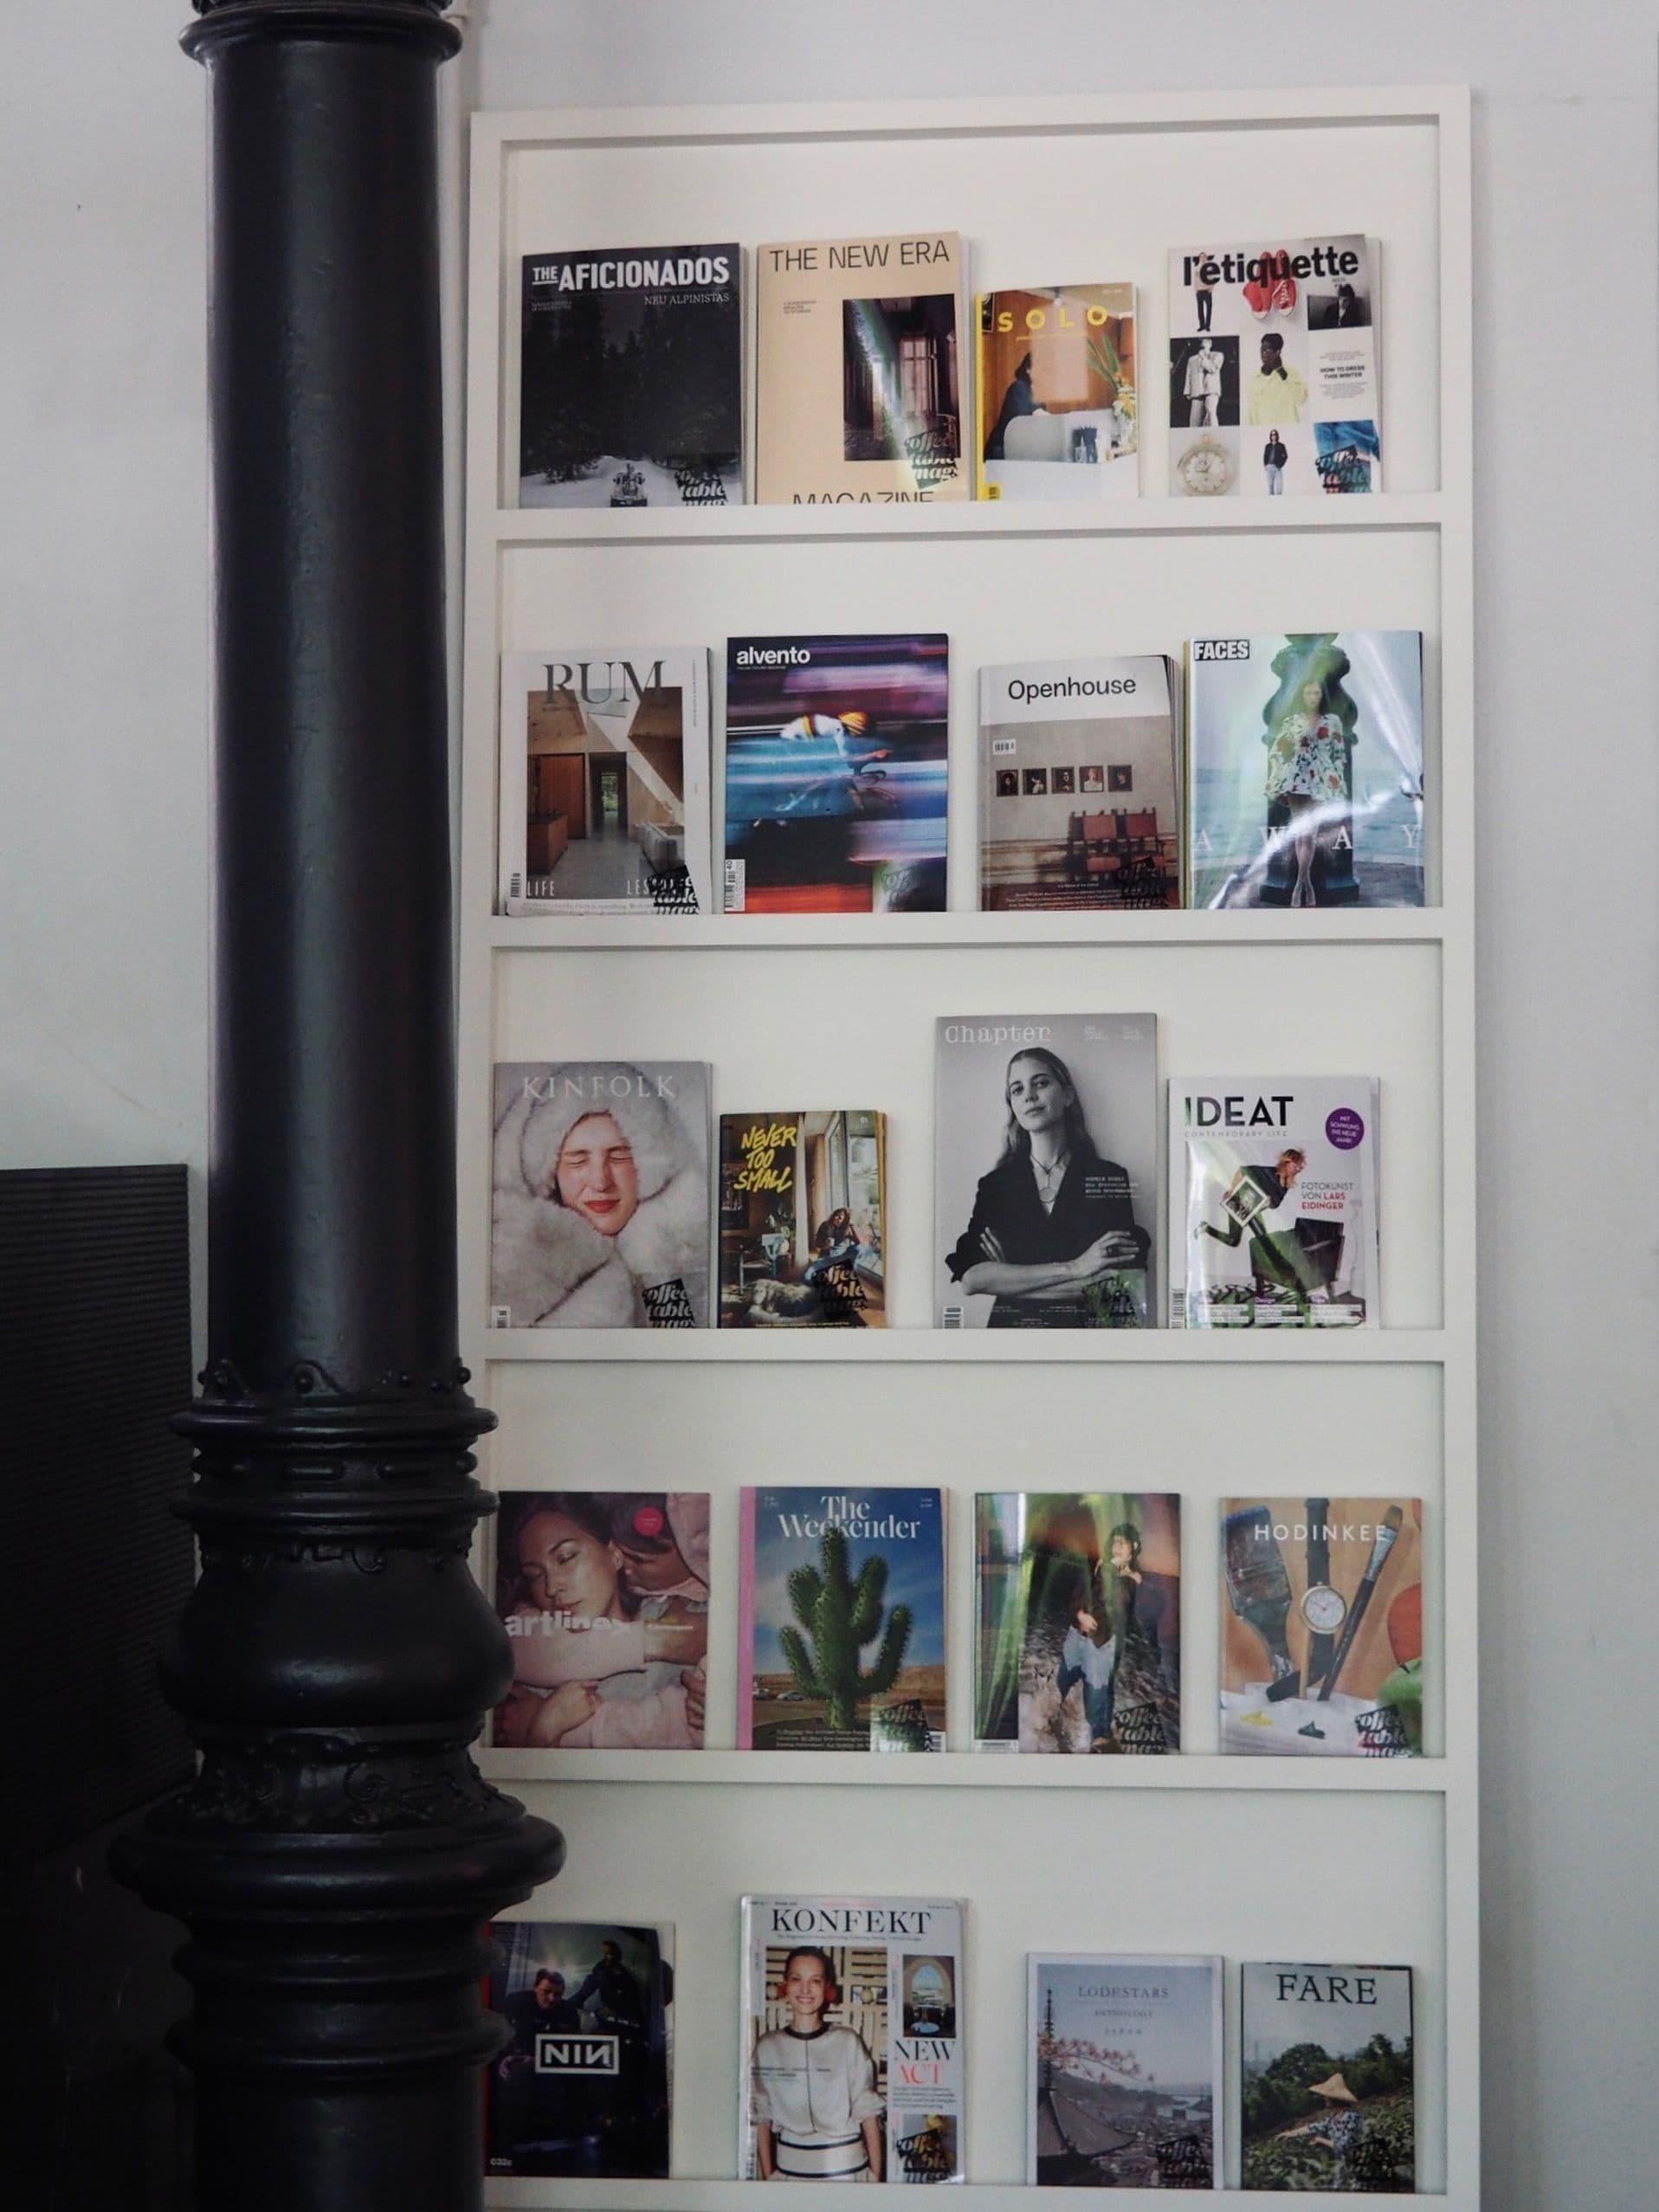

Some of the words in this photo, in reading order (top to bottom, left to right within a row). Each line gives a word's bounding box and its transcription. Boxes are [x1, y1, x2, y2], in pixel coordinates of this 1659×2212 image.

[770, 248, 818, 273] THE
[830, 244, 889, 269] NEW
[901, 240, 950, 265] ERA
[533, 266, 558, 282] THE
[558, 256, 730, 292] AFICIONADOS
[670, 293, 730, 305] ALPINISTAS
[997, 305, 1108, 332] SOLO
[736, 646, 810, 665] alvento
[1194, 641, 1249, 660] FACES
[542, 661, 667, 705] RUM
[1008, 676, 1136, 705] Openhouse
[526, 880, 556, 897] LIFE
[945, 1025, 1053, 1045] Chapter
[523, 1075, 676, 1099] KINFOLK
[1185, 1095, 1294, 1126] IDEAT
[740, 1123, 797, 1150] NEVER
[746, 1147, 776, 1169] TOO
[733, 1166, 793, 1193] SMALL
[1301, 1182, 1354, 1190] FOTOKUNST
[1301, 1191, 1321, 1200] VON
[1323, 1191, 1346, 1200] LARS
[820, 1495, 870, 1519] The
[778, 1513, 921, 1538] Weekender
[1255, 1524, 1389, 1541] HODINKEE
[771, 1908, 932, 1934] KONFEKT
[1078, 1987, 1169, 1998] LODESTARS
[1276, 1973, 1378, 2005] FARE
[545, 2043, 610, 2065] NIN
[894, 2040, 955, 2060] NEW
